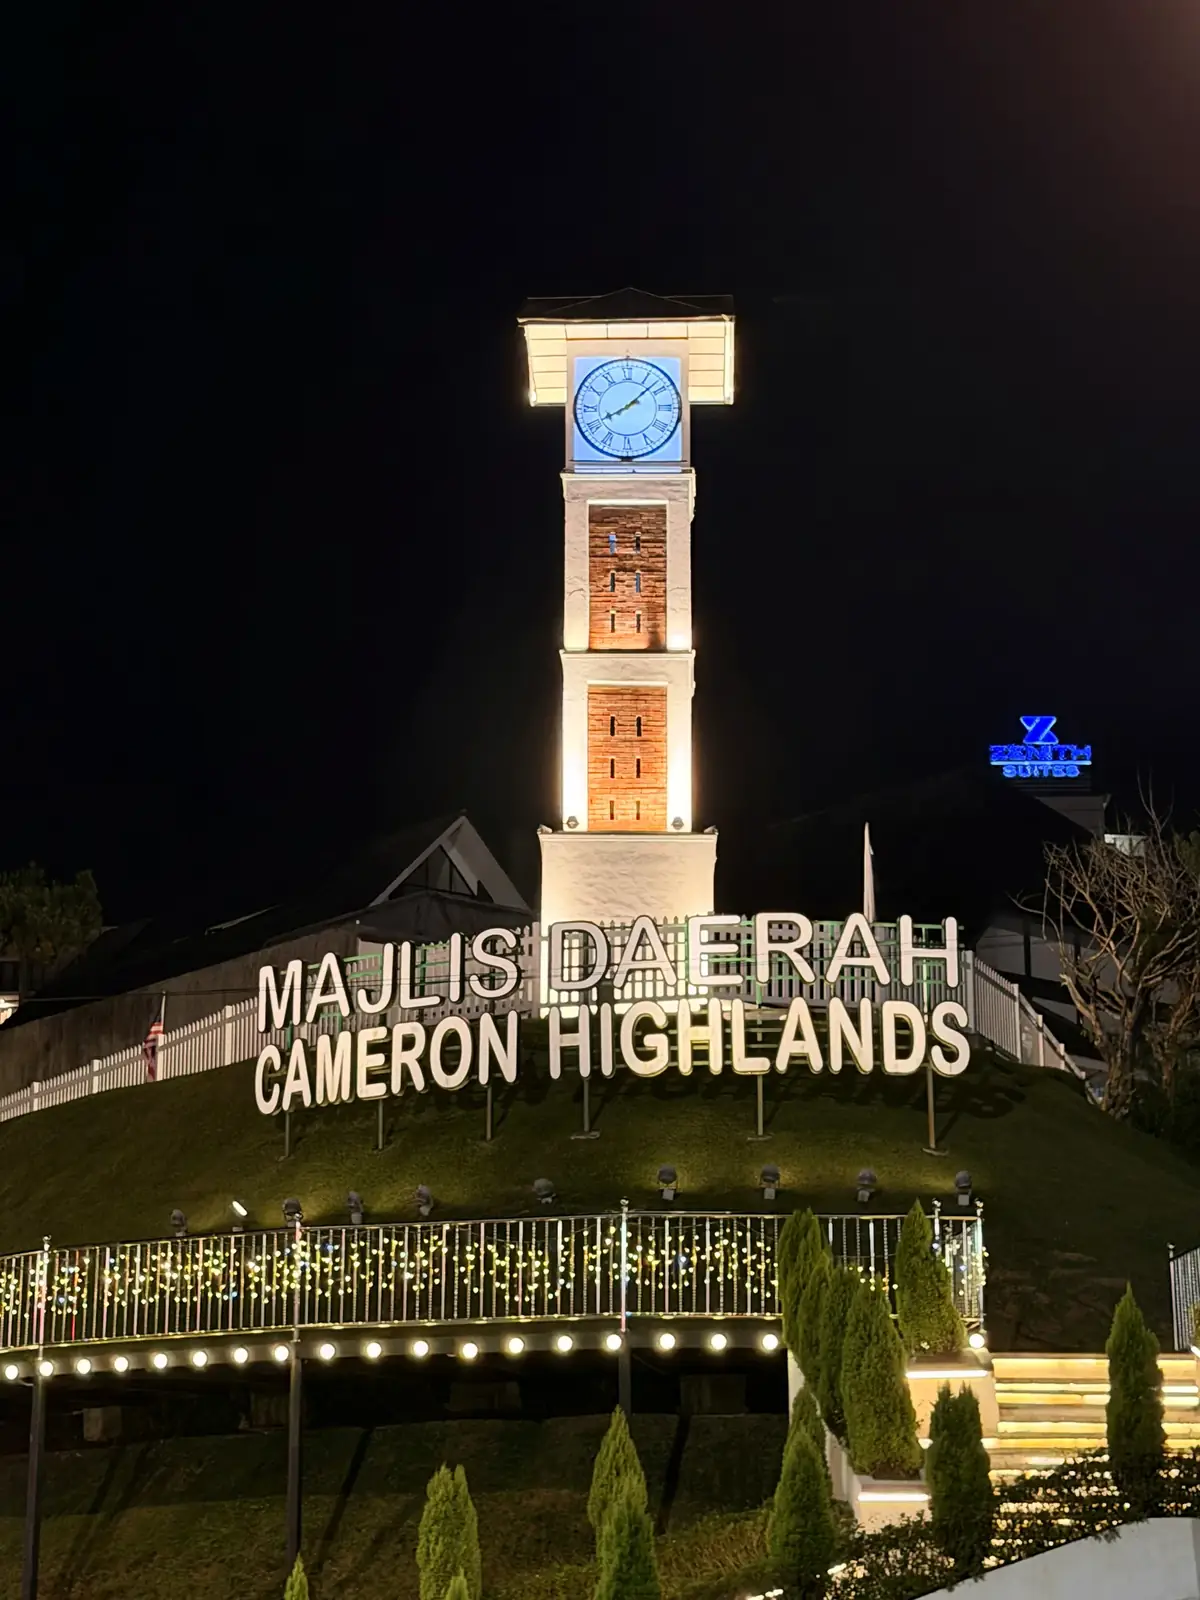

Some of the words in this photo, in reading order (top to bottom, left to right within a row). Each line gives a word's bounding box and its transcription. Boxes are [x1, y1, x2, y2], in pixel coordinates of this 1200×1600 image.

[258, 928, 521, 1033] MAJLIS
[549, 912, 960, 991] DAERAH
[254, 1010, 519, 1115] CAMERON
[548, 997, 971, 1079] HIGHLANDS
